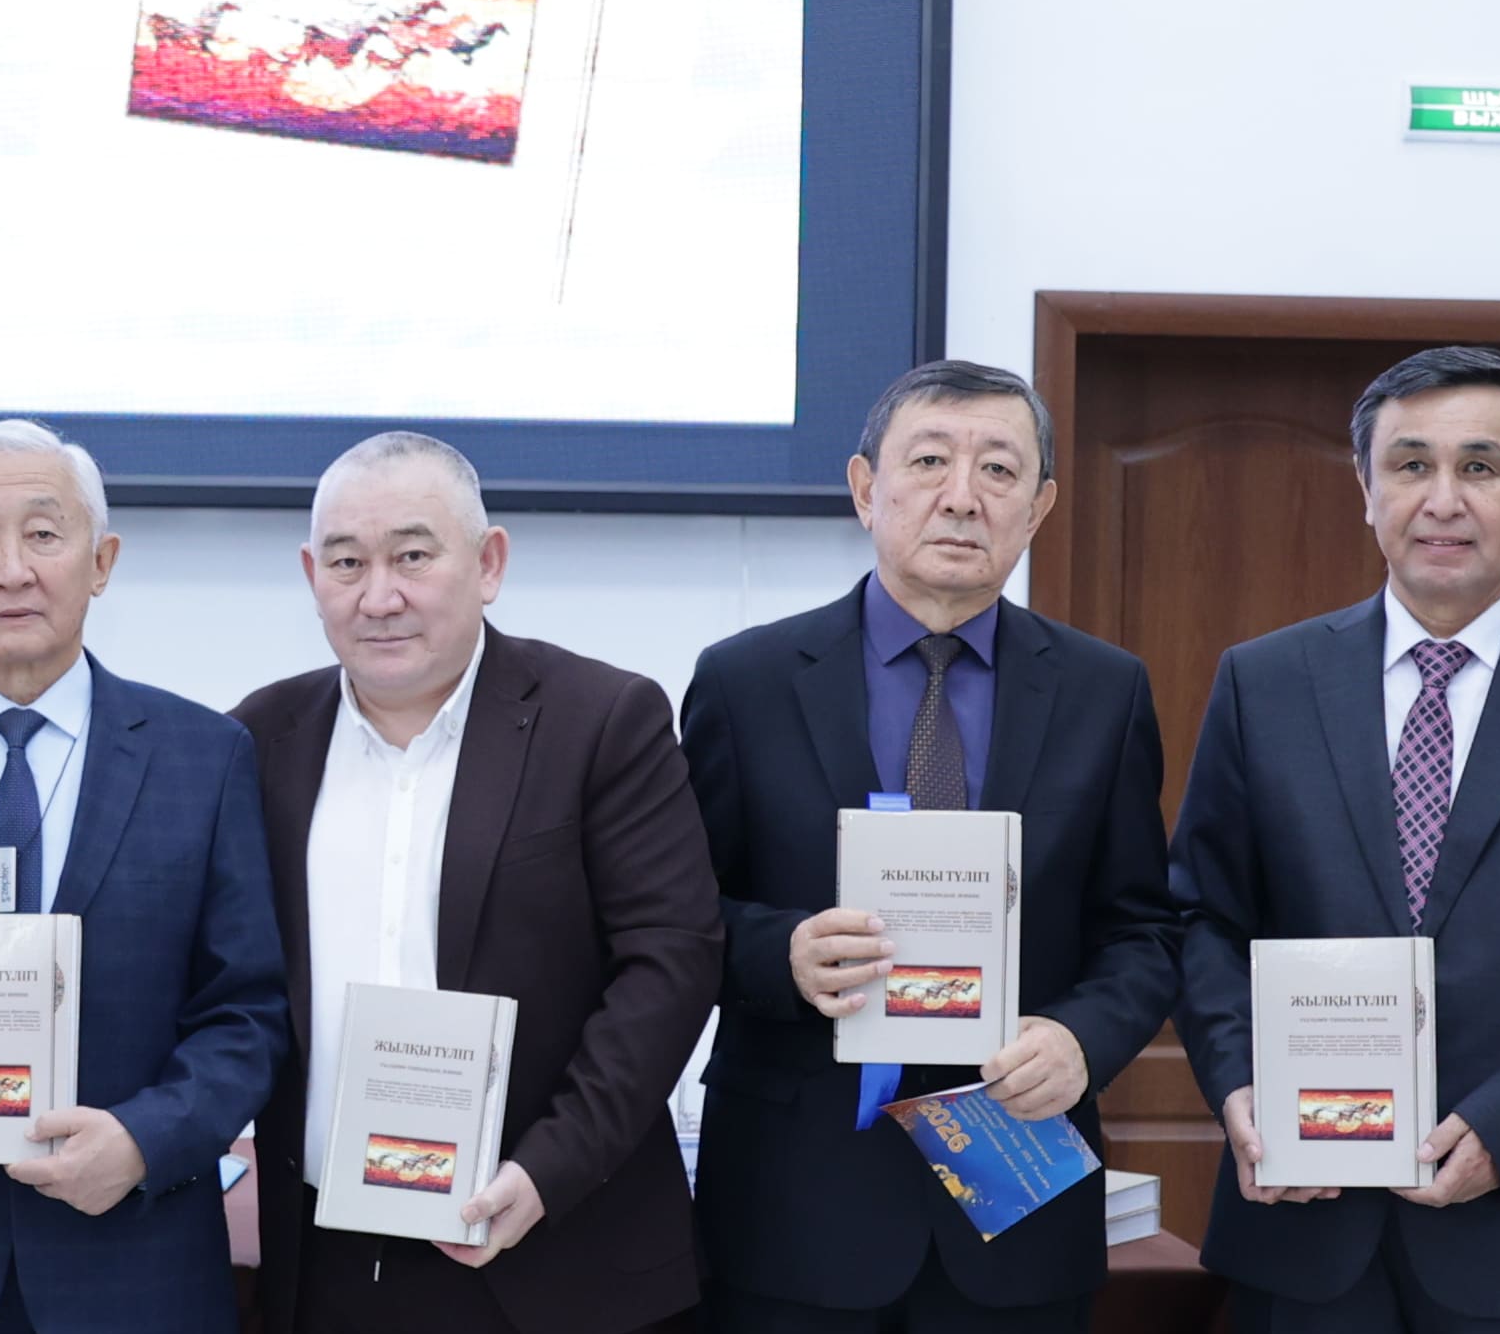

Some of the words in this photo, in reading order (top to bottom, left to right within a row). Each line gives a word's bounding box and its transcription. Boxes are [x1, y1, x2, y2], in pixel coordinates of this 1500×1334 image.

[881, 870, 943, 883] ЖЫЛҚЫ
[1291, 995, 1351, 1008] ЖЫЛҚЫ
[917, 1099, 973, 1154] 2026
